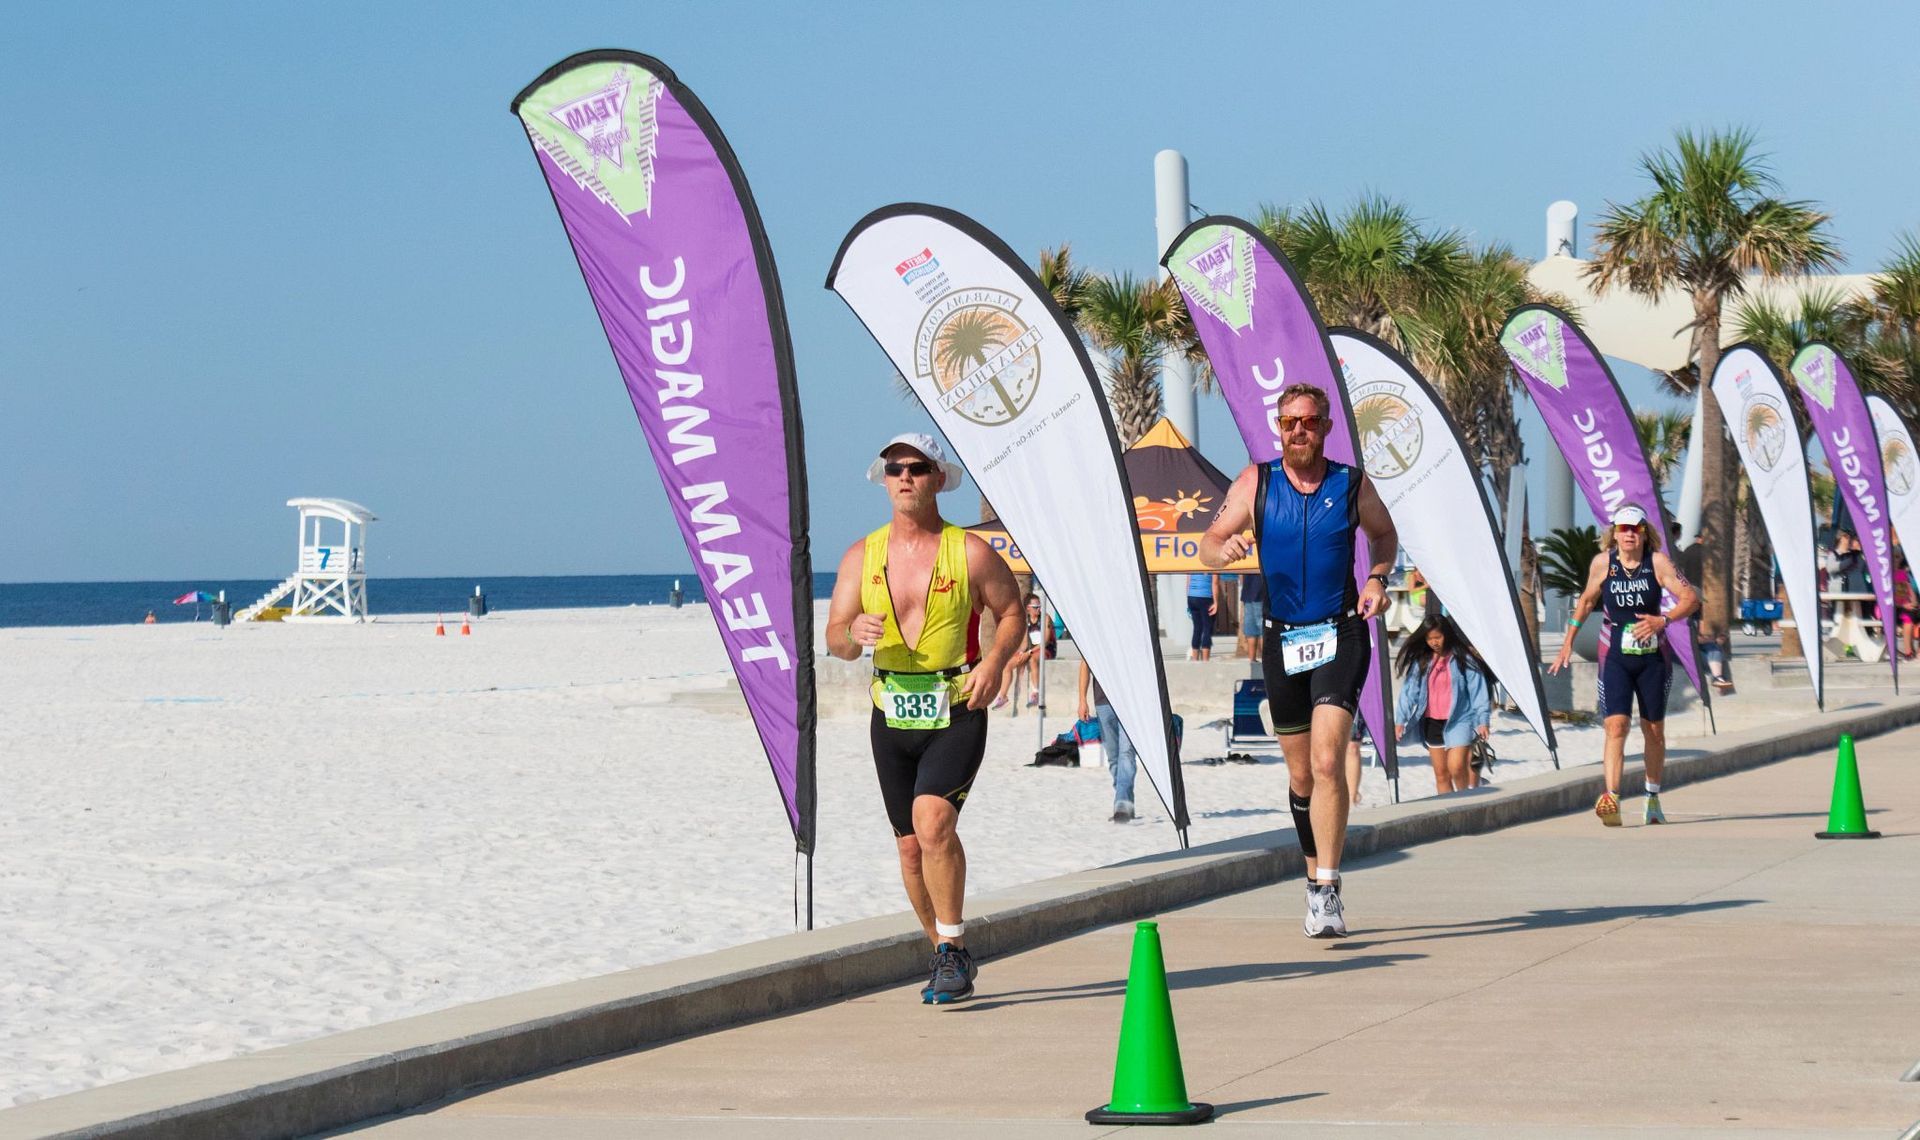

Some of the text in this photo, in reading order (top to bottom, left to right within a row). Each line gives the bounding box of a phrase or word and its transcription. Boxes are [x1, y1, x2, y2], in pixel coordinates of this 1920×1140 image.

[317, 547, 331, 570] 7
[1610, 578, 1650, 594] CALLAHAN
[1296, 641, 1325, 664] 137
[892, 693, 938, 719] 833
